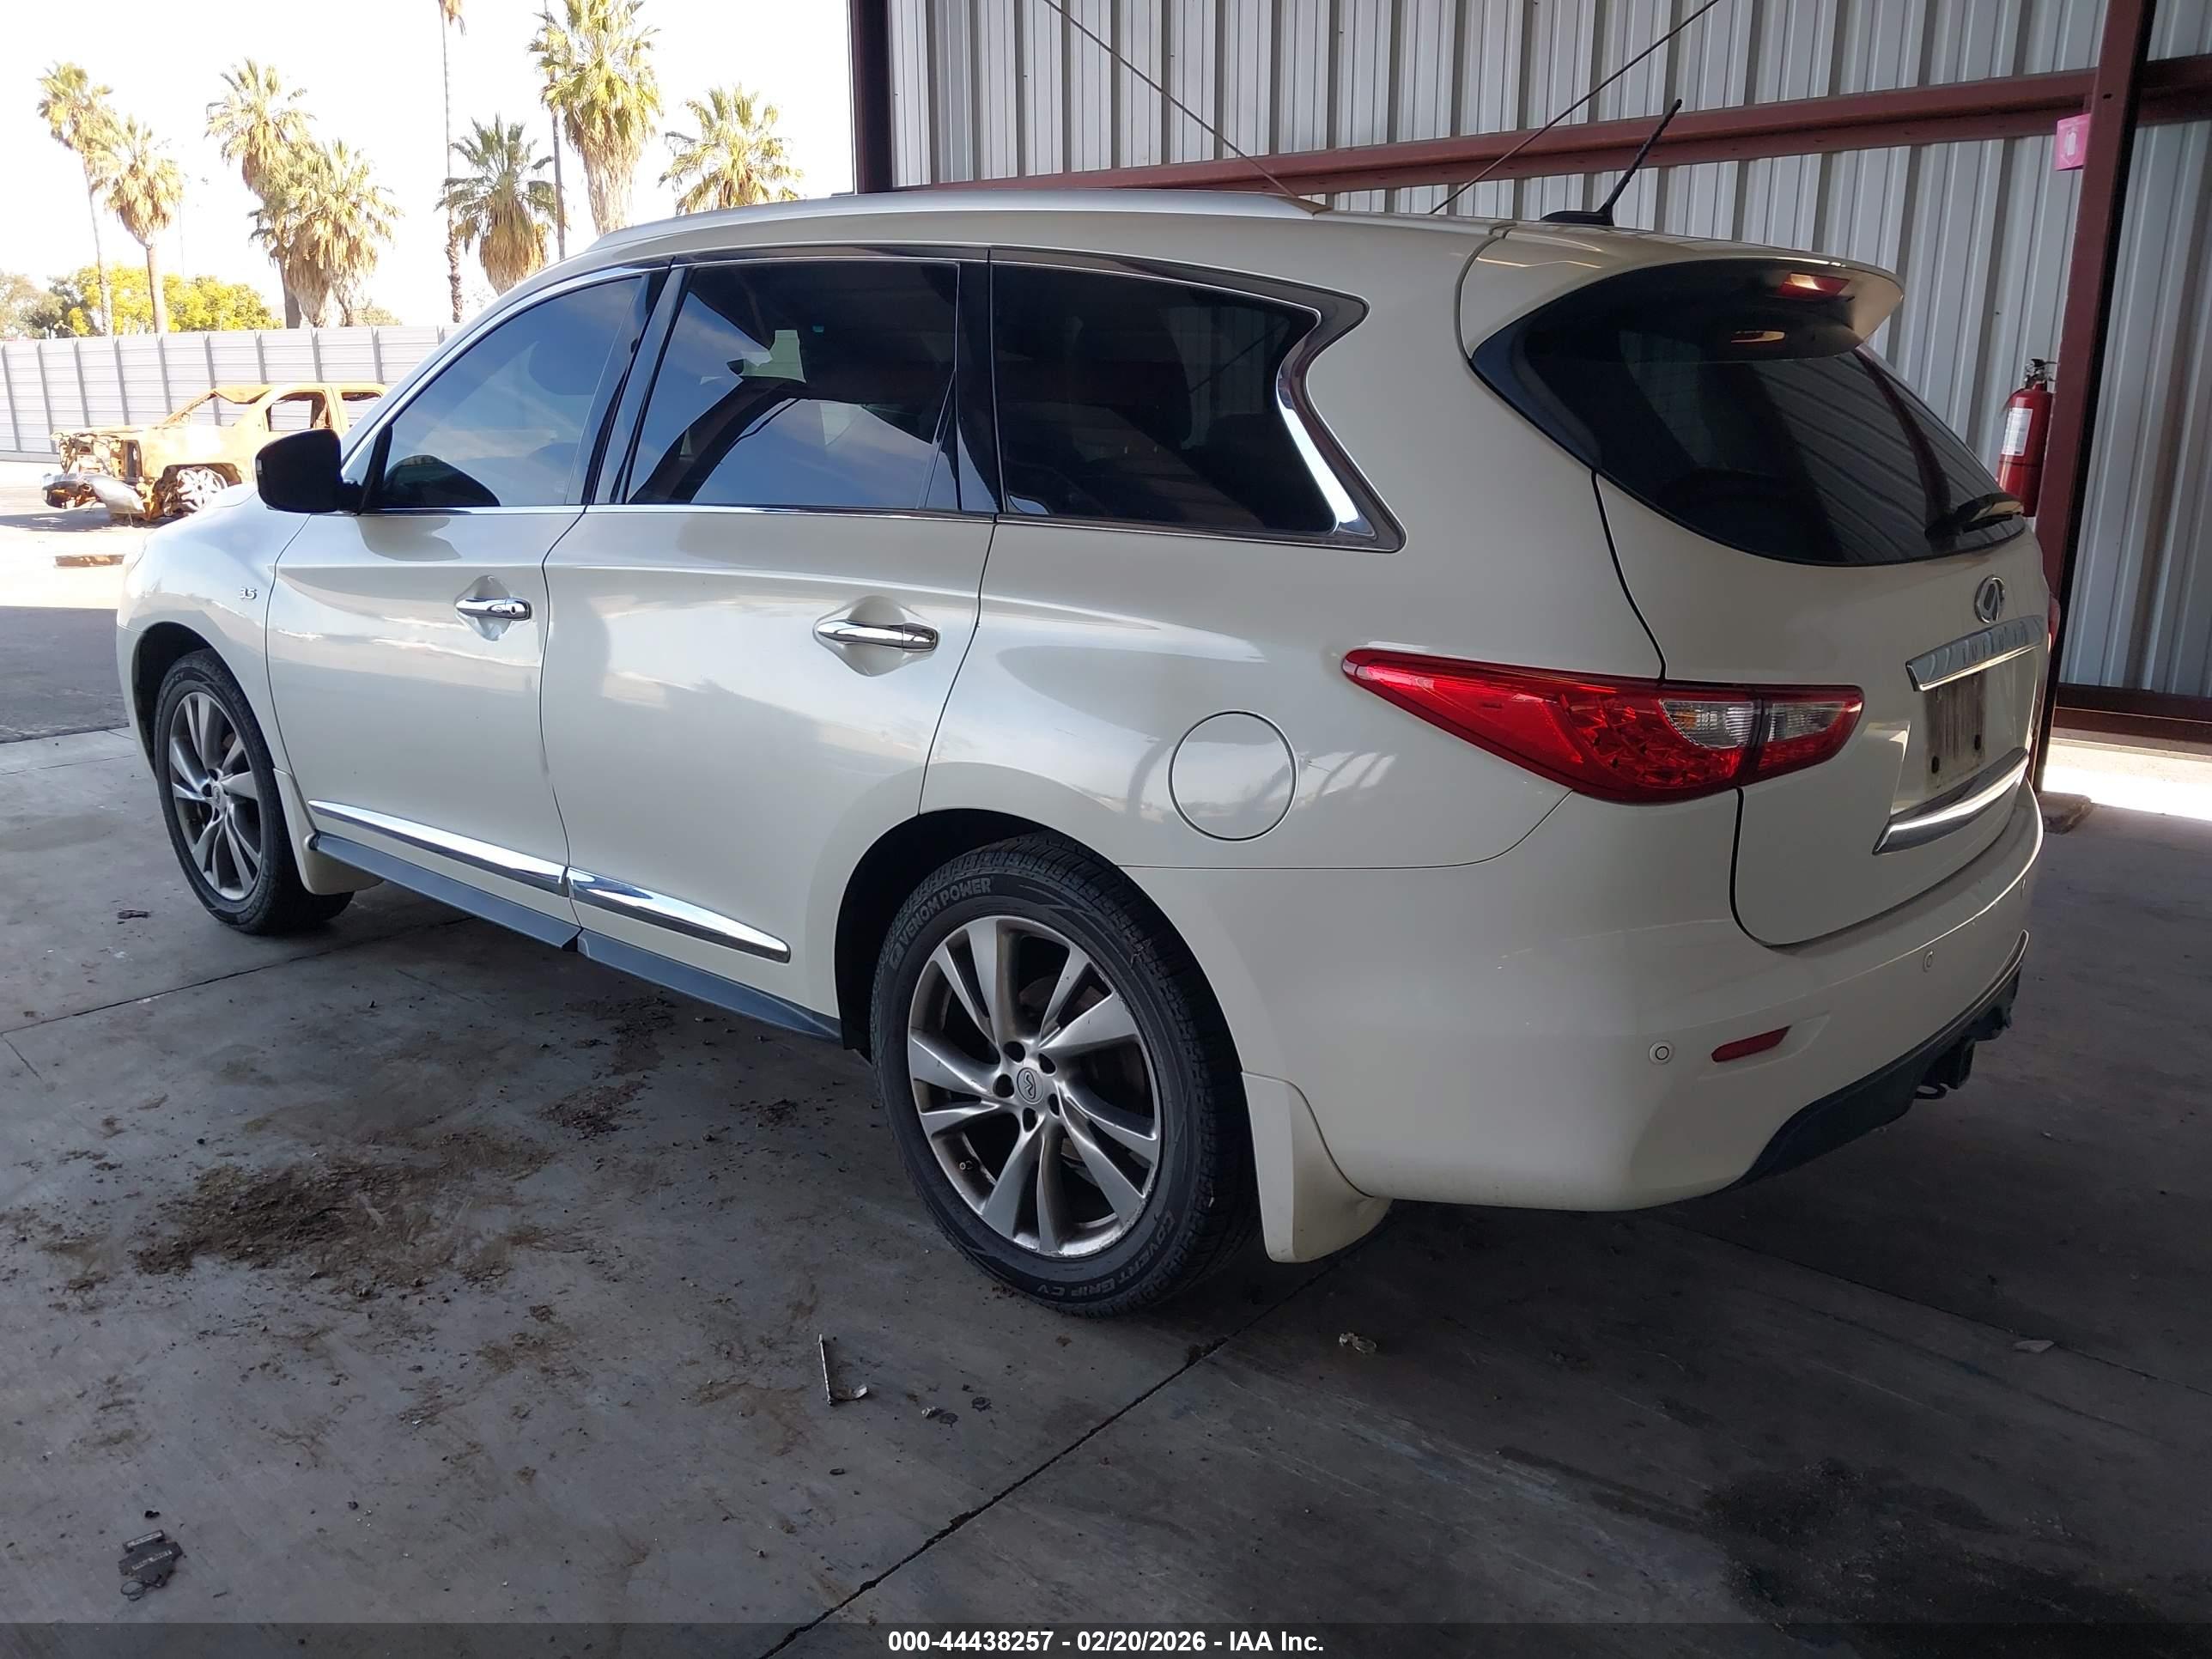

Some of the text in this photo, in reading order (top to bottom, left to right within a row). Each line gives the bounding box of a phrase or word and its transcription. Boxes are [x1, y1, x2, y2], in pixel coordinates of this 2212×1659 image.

[899, 877, 991, 945] VENOM POWER
[1118, 1210, 1176, 1285] COVERT
[1036, 1284, 1066, 1297] CV
